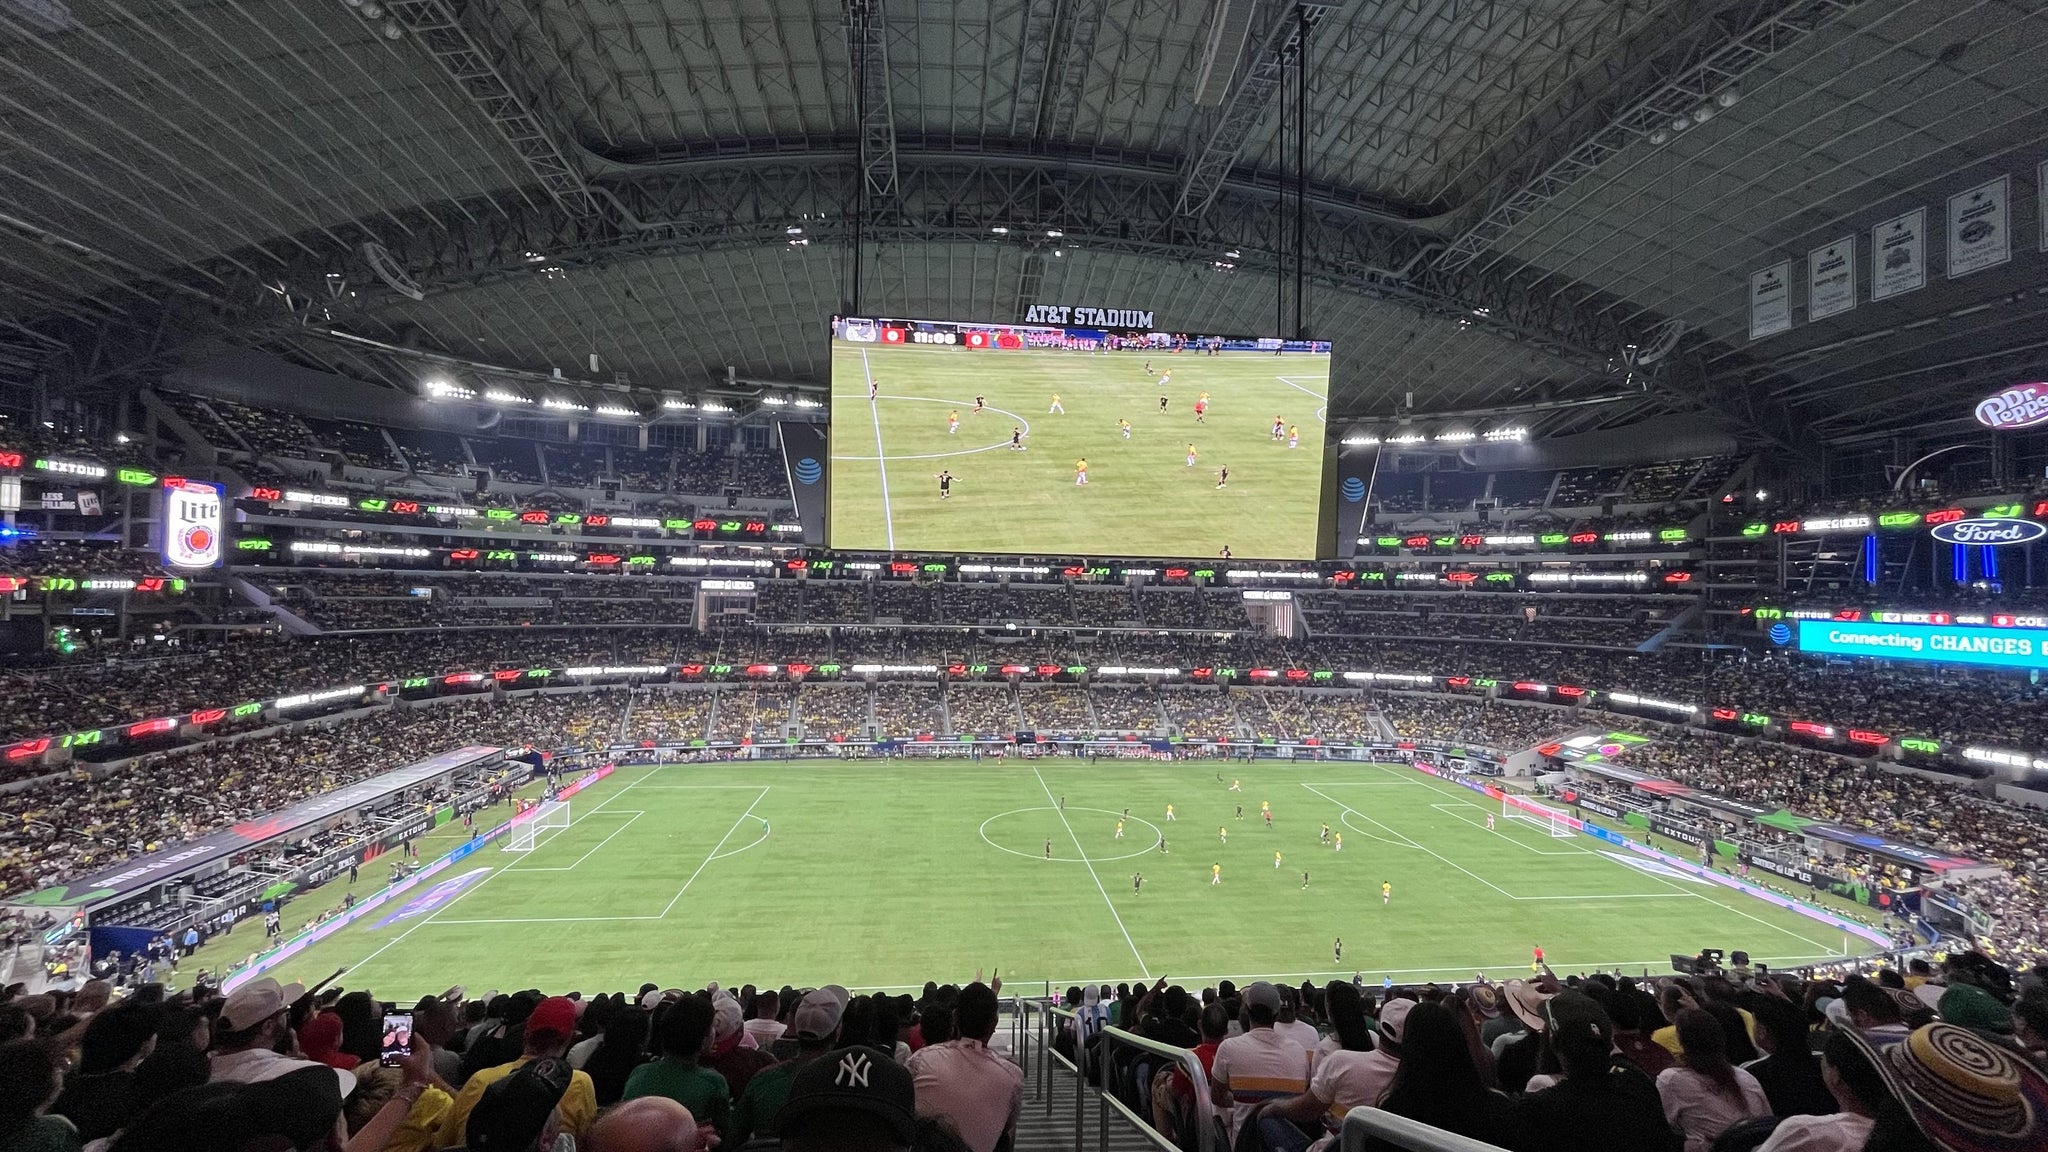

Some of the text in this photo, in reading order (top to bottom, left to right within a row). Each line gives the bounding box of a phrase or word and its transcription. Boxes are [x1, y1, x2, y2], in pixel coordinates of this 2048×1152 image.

[1025, 304, 1154, 329] AT&T STADIUM
[913, 331, 957, 345] 11:06
[2000, 388, 2037, 409] Dr
[35, 459, 106, 477] MEXTOUR
[42, 492, 63, 501] LESS
[179, 500, 218, 524] Lite
[1953, 522, 2023, 541] Ford
[2015, 616, 2047, 627] COL
[1829, 630, 1923, 652] Connecting
[1930, 634, 2033, 656] CHANGES
[834, 1052, 873, 1088] NY
